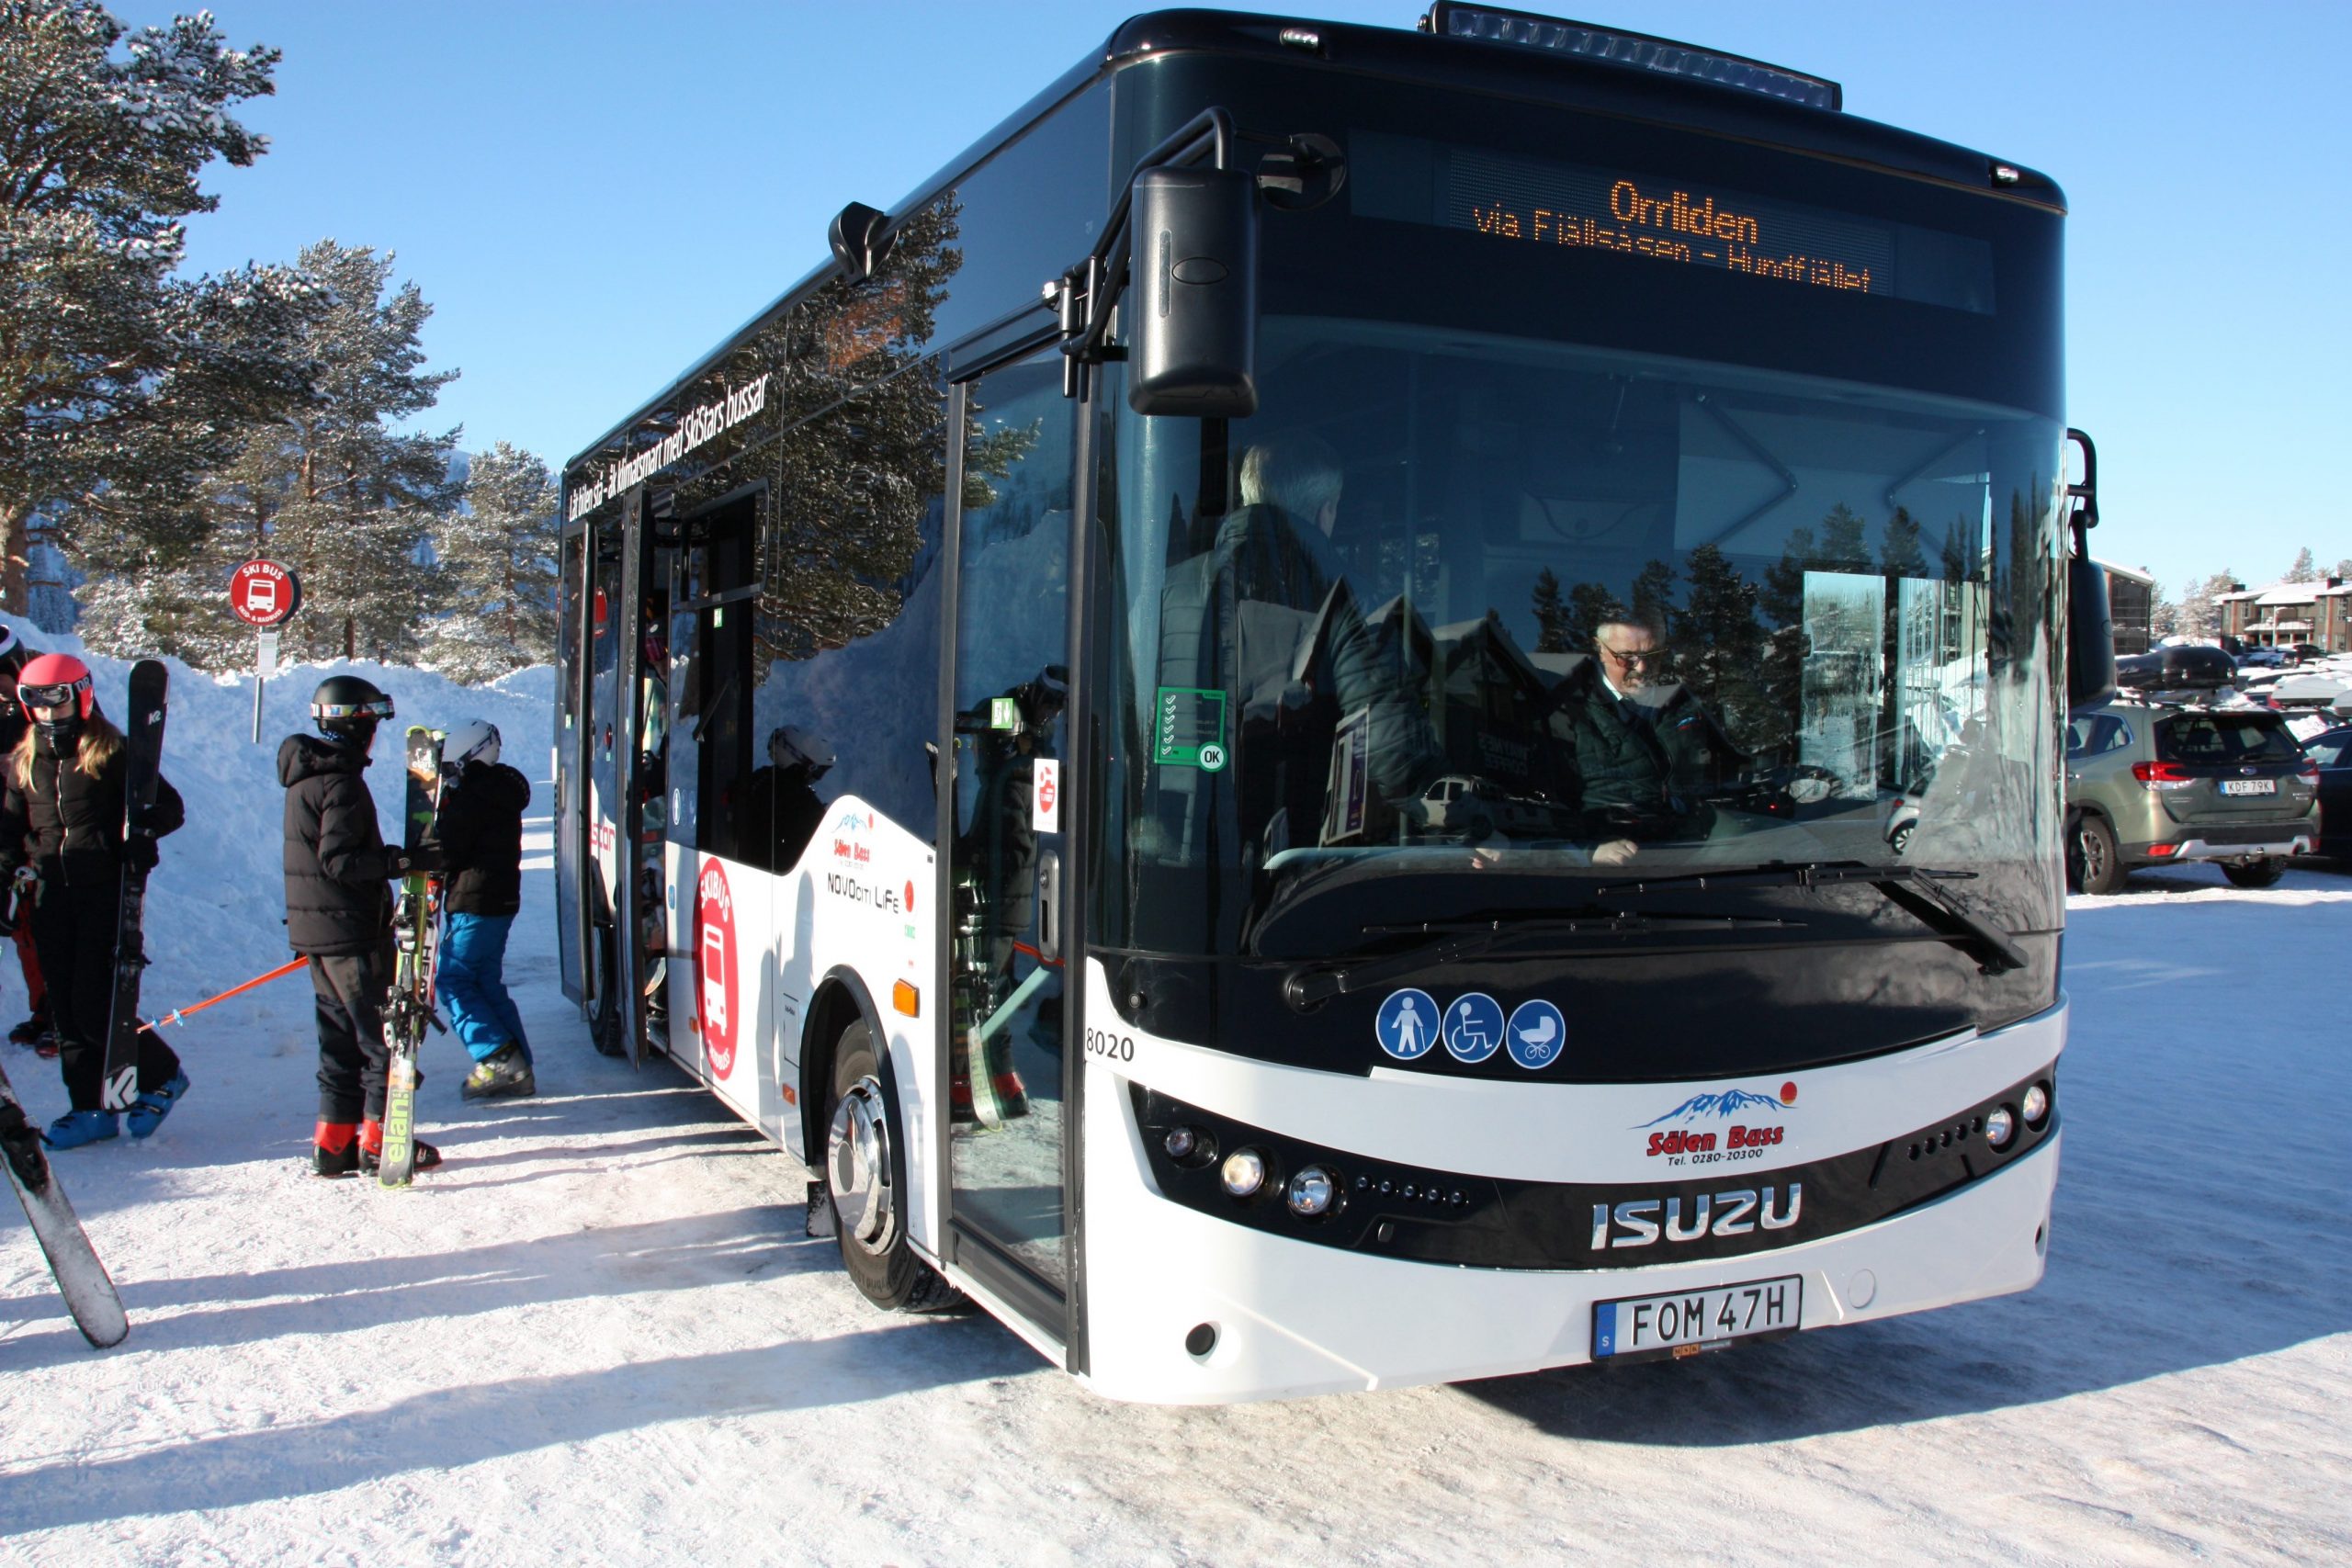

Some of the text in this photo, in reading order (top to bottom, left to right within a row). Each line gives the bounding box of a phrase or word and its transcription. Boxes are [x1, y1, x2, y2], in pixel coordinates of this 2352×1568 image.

[1473, 202, 1521, 239] via
[1610, 180, 1758, 245] Orrliden
[616, 436, 663, 495] klimatsmart
[663, 416, 684, 468] med
[684, 400, 725, 455] SkiStars
[726, 372, 769, 430] bussar
[242, 563, 285, 581] SKI BUS
[1204, 750, 1221, 764] OK
[422, 944, 433, 989] HEA
[1086, 1026, 1135, 1063] 8020
[1646, 1130, 1717, 1157] Sälen
[1668, 1147, 1763, 1167] Tel. 0280-20300
[1590, 1182, 1802, 1250] ISUZU
[1631, 1284, 1785, 1347] FOM 47H
[1601, 1336, 1611, 1348] S
